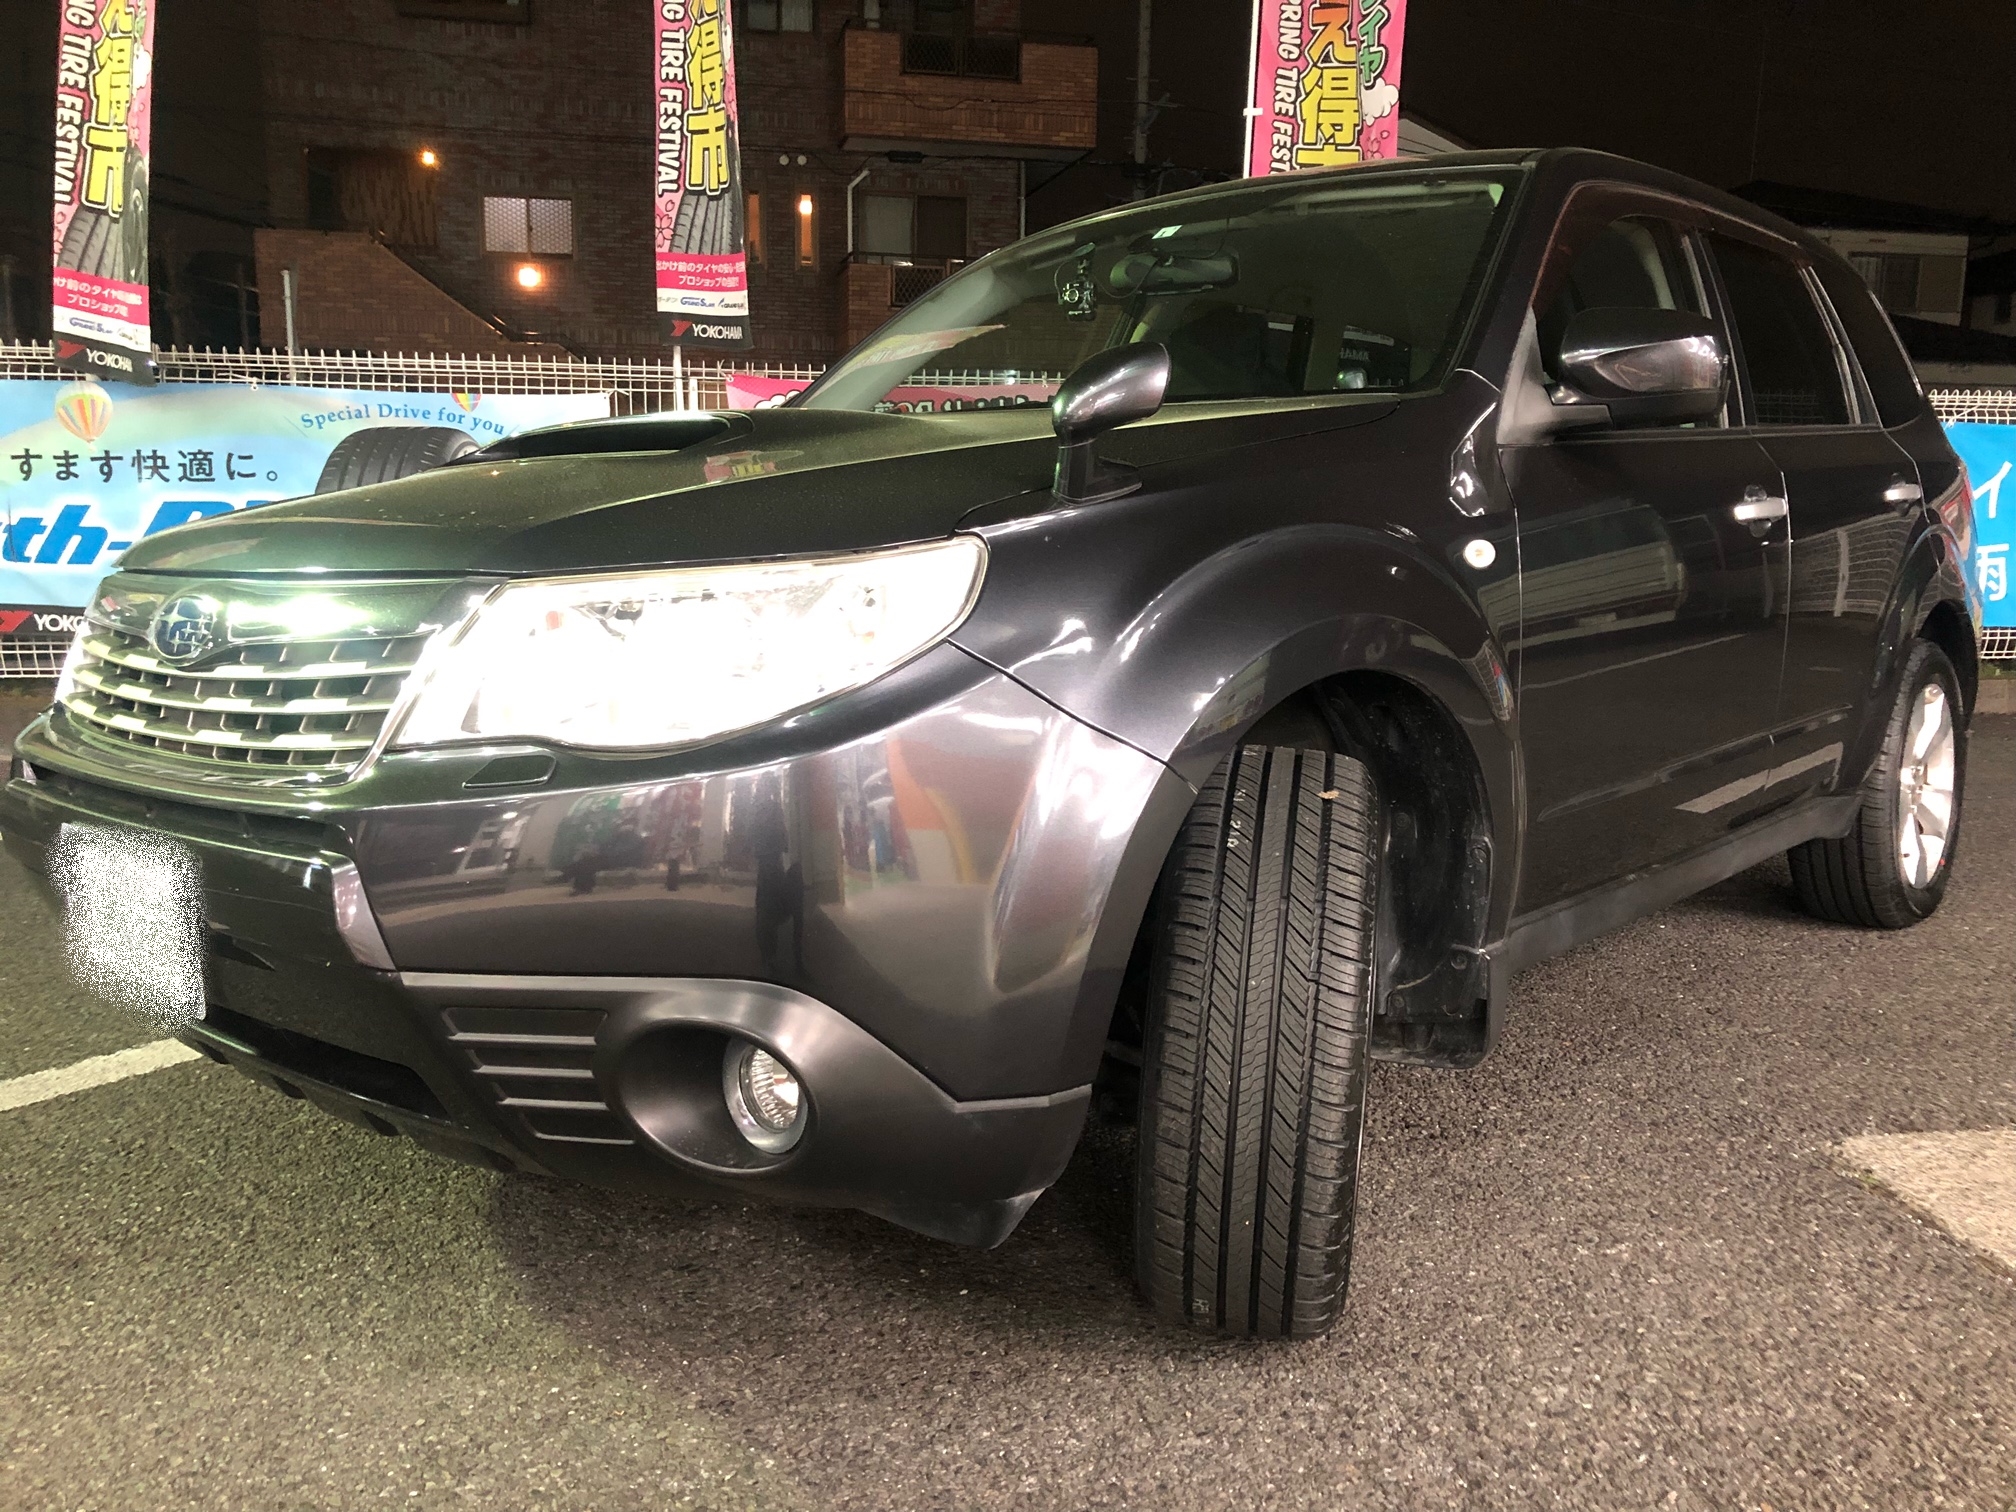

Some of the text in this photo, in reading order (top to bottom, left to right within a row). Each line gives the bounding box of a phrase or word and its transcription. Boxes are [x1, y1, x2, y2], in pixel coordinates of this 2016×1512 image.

[59, 35, 92, 89] TIRE
[1359, 0, 1385, 83] イヤ
[657, 0, 685, 196] G TIRE FESTIVAL
[687, 0, 729, 191] 得市
[1273, 68, 1299, 117] TIRE
[1296, 0, 1361, 167] え得
[1270, 121, 1293, 174] FEST
[692, 323, 743, 340] YOKOHAMA
[301, 403, 505, 436] Special Drive for you
[10, 448, 278, 483] すます快適に。
